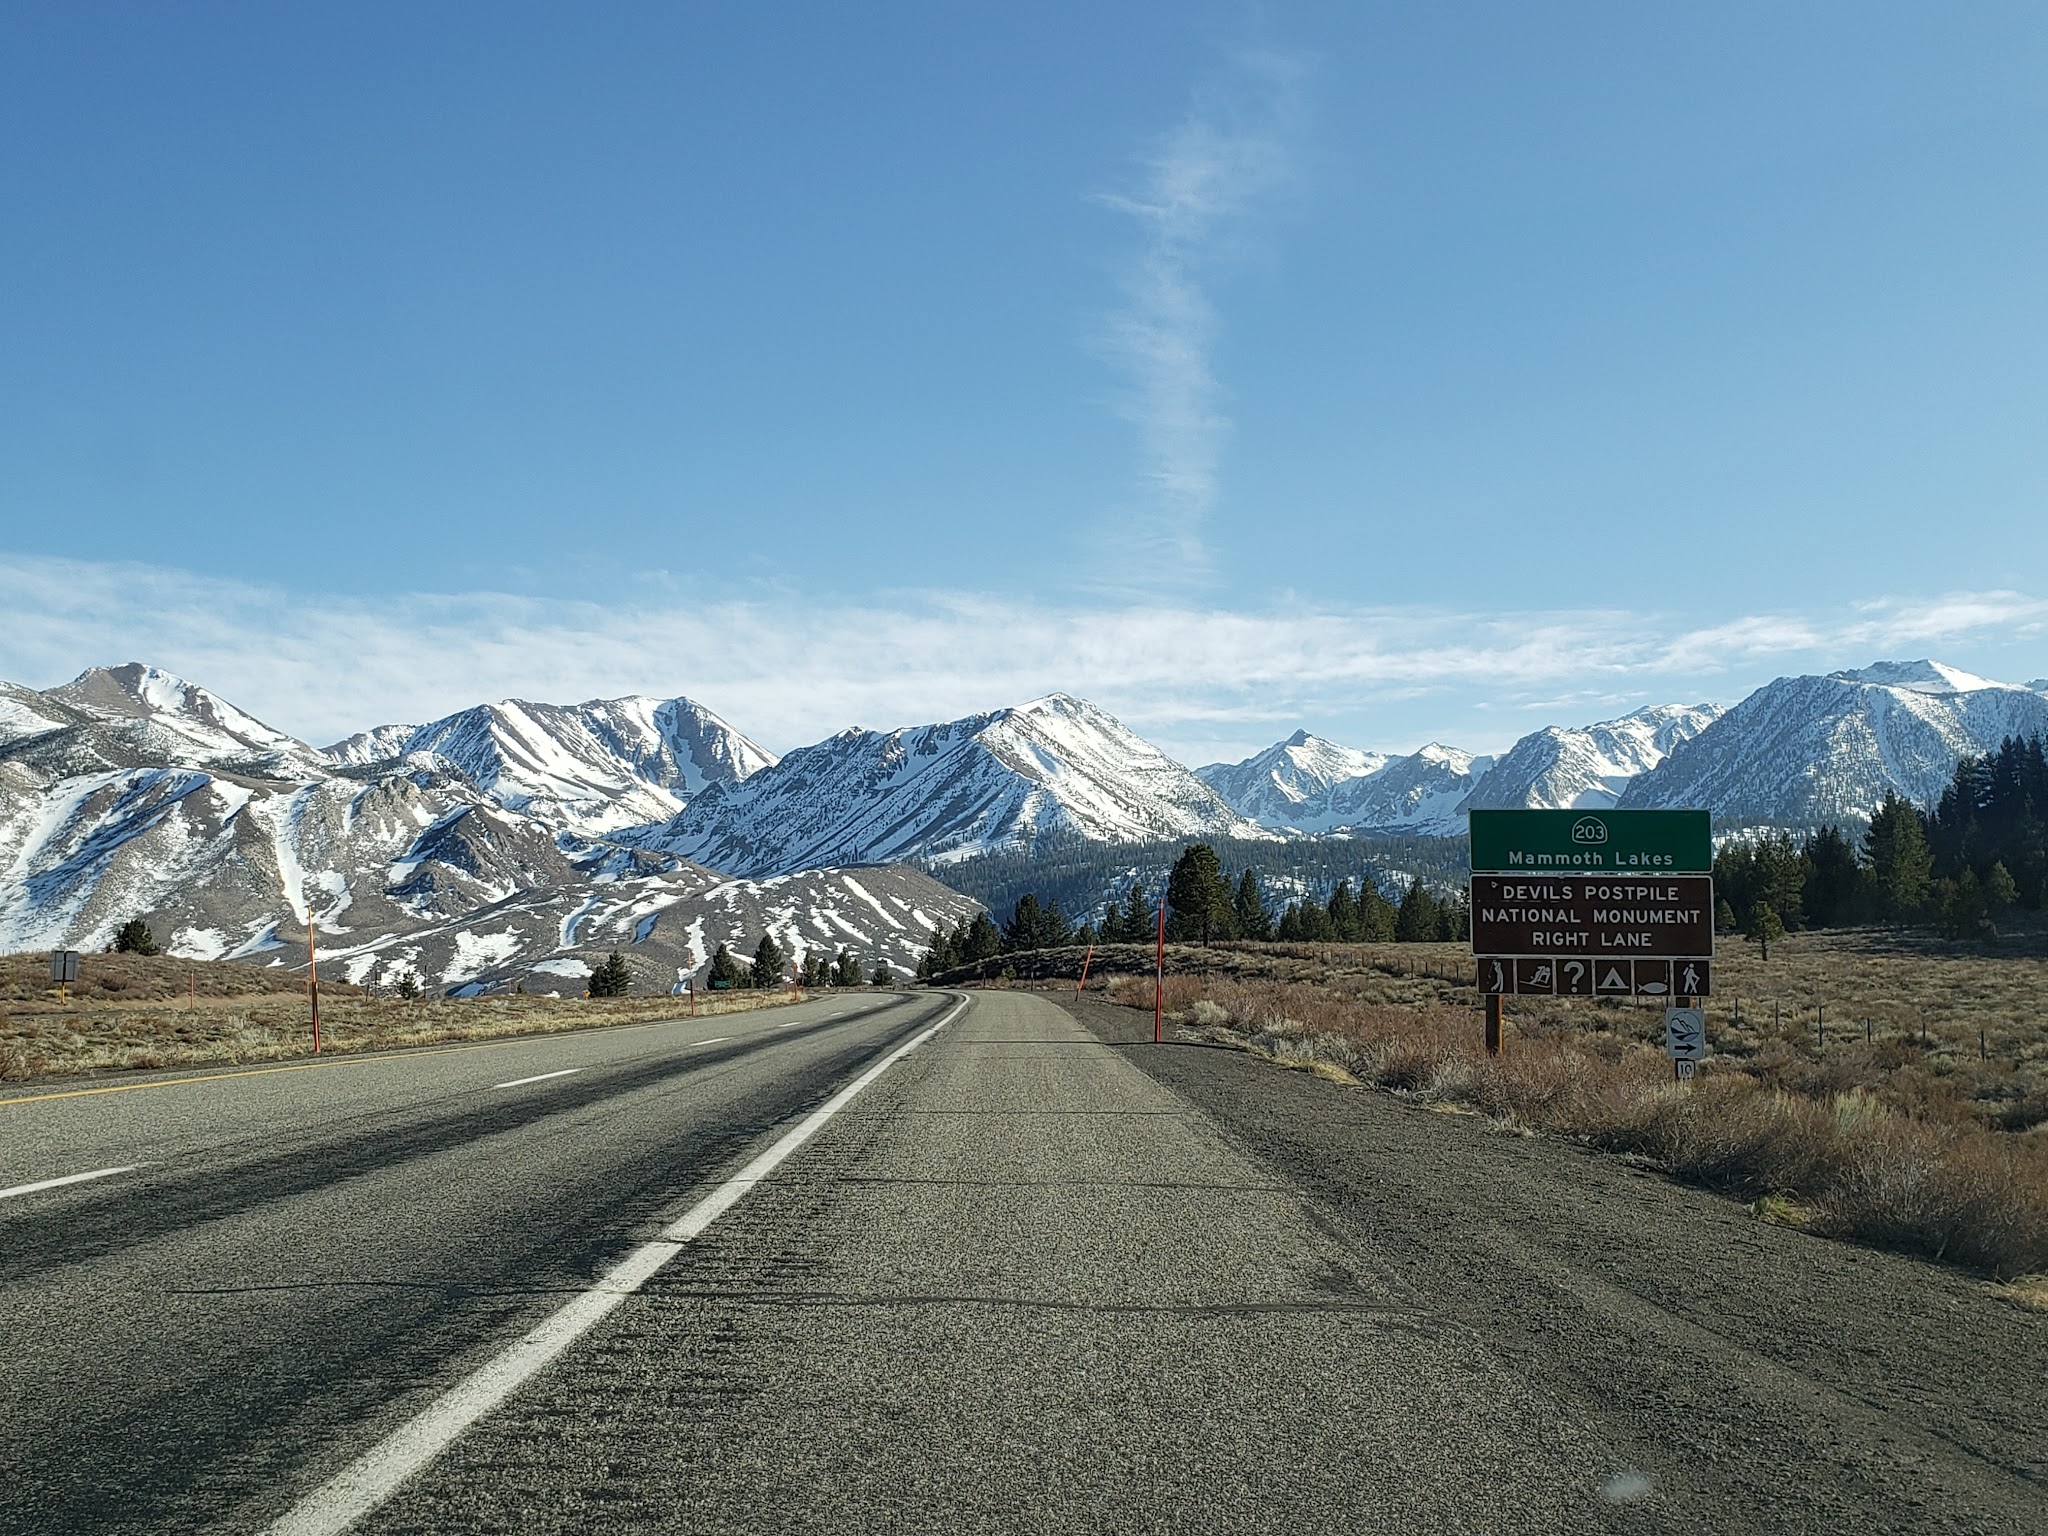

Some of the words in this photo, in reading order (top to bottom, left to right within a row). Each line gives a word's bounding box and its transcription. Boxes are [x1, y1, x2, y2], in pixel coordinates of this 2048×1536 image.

[1574, 824, 1605, 840] 203
[1509, 851, 1602, 866] Mammoth
[1616, 851, 1673, 866] Lakes
[1503, 885, 1573, 900] DEVILS
[1585, 886, 1679, 901] POSTPILE
[1482, 908, 1581, 923] NATIONAL
[1593, 909, 1700, 924] MONUMENT
[1532, 931, 1589, 946] RIGHT
[1601, 932, 1652, 947] LANE
